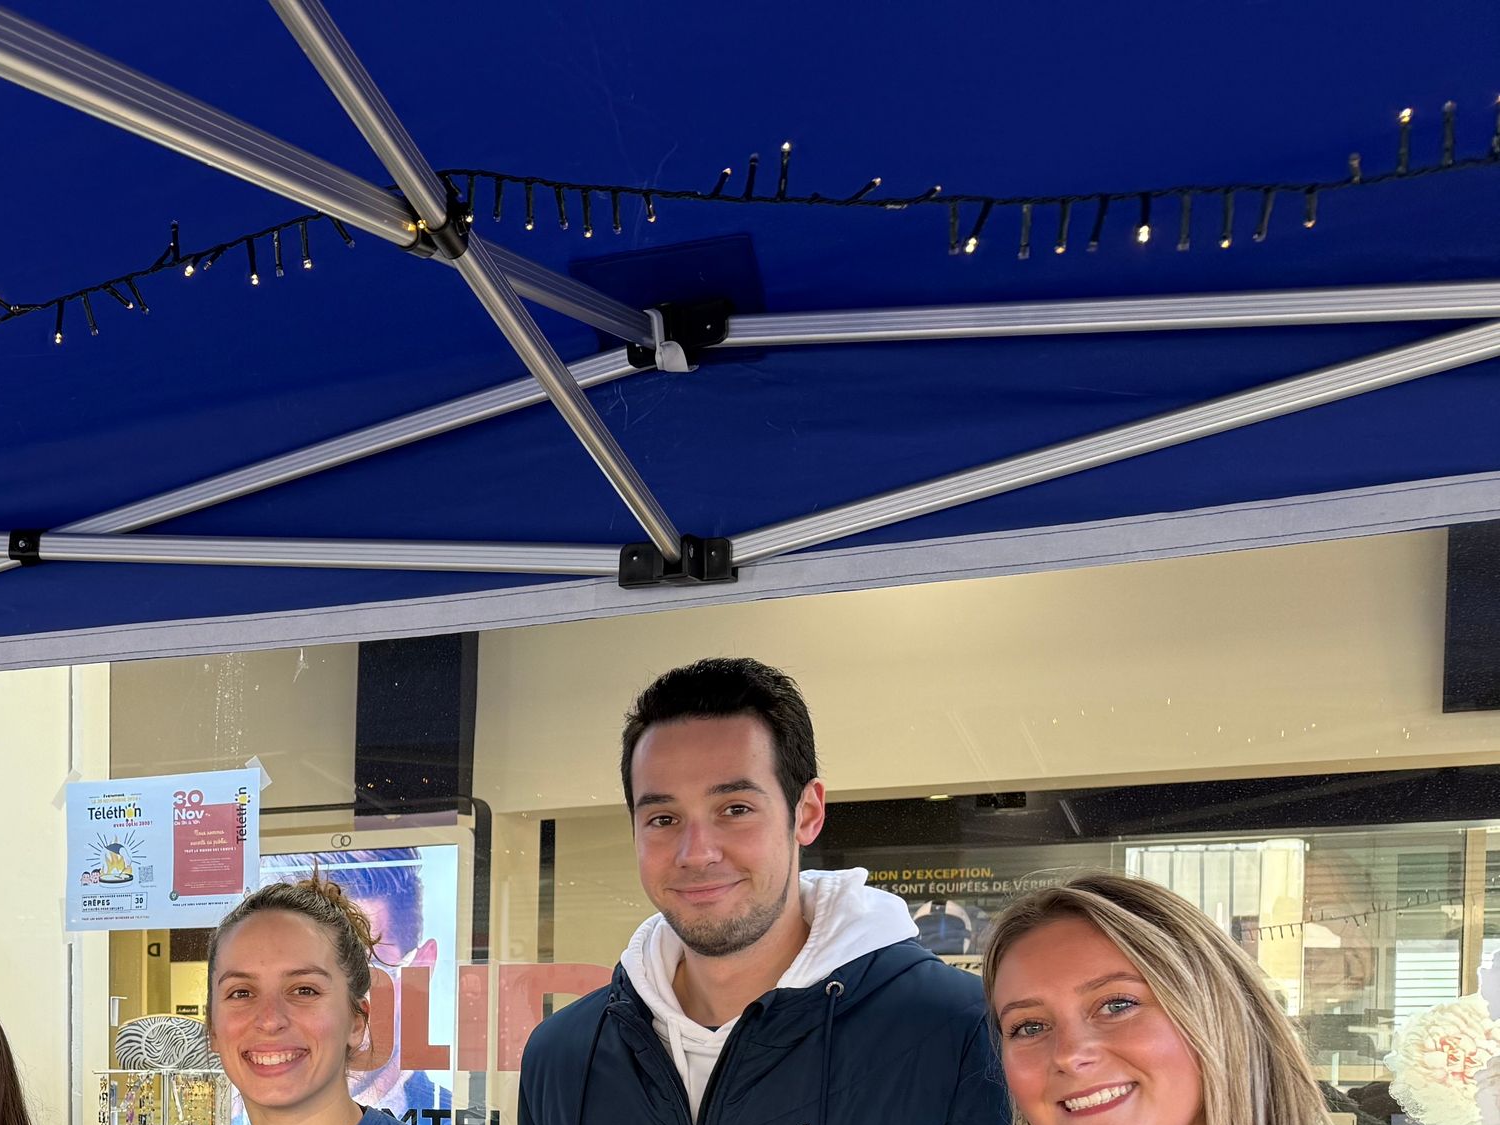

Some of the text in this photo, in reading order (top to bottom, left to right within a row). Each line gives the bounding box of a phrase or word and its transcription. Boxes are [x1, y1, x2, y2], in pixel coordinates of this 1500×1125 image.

[173, 790, 204, 808] 30
[175, 808, 204, 821] Nov
[868, 868, 994, 881] SION D'EXCEPTION,
[891, 883, 925, 895] SONT
[929, 880, 989, 895] ÉQUIPÉES
[993, 881, 1010, 892] DE
[83, 899, 110, 907] CRÊPES
